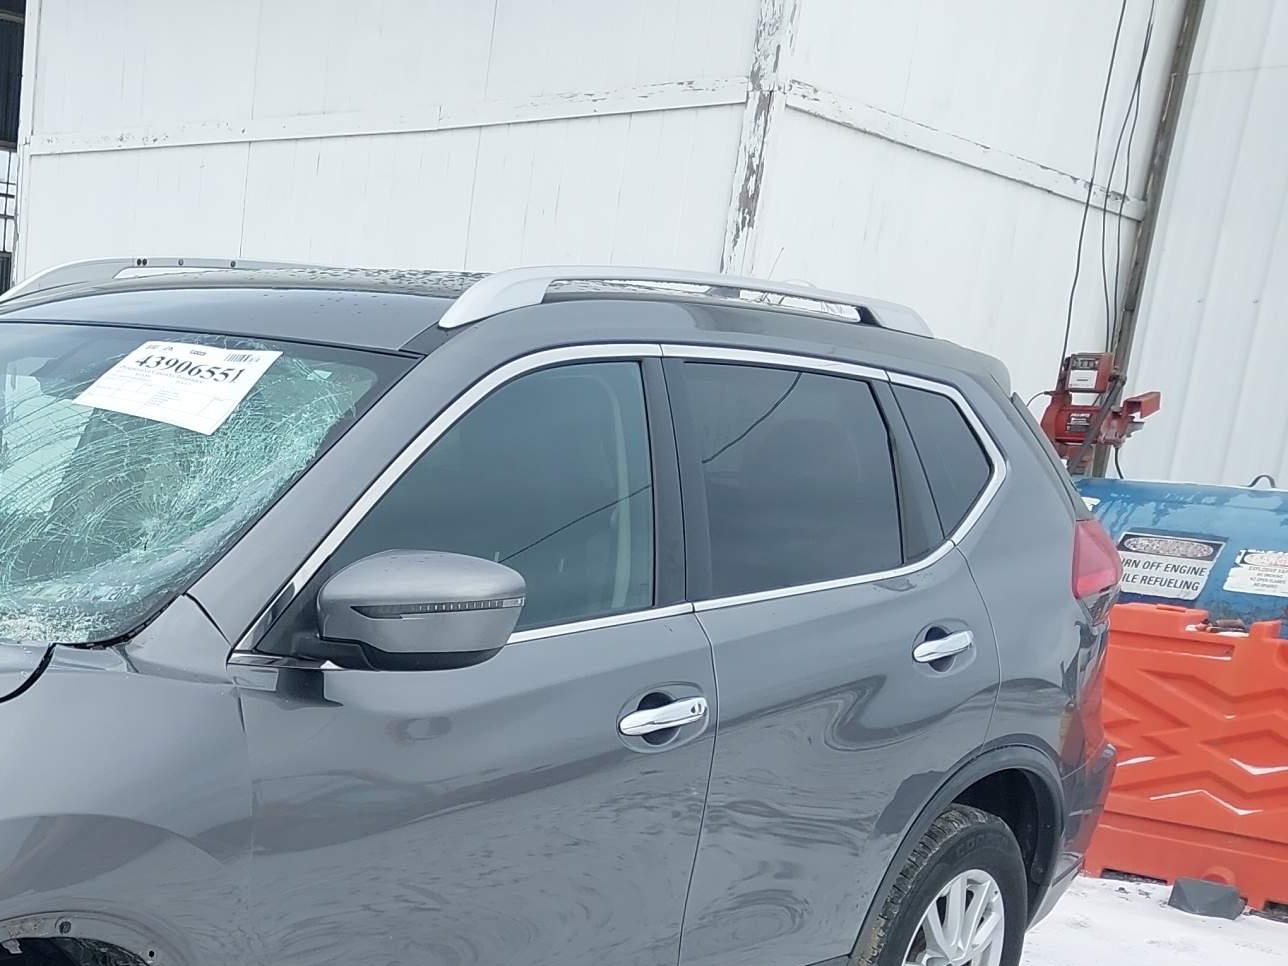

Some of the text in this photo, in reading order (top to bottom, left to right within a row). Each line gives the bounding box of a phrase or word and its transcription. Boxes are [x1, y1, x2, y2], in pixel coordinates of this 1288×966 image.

[136, 355, 245, 382] 43906551
[1142, 560, 1163, 570] OFF
[1163, 563, 1207, 576] ENGINE
[1139, 575, 1200, 591] REFUELING
